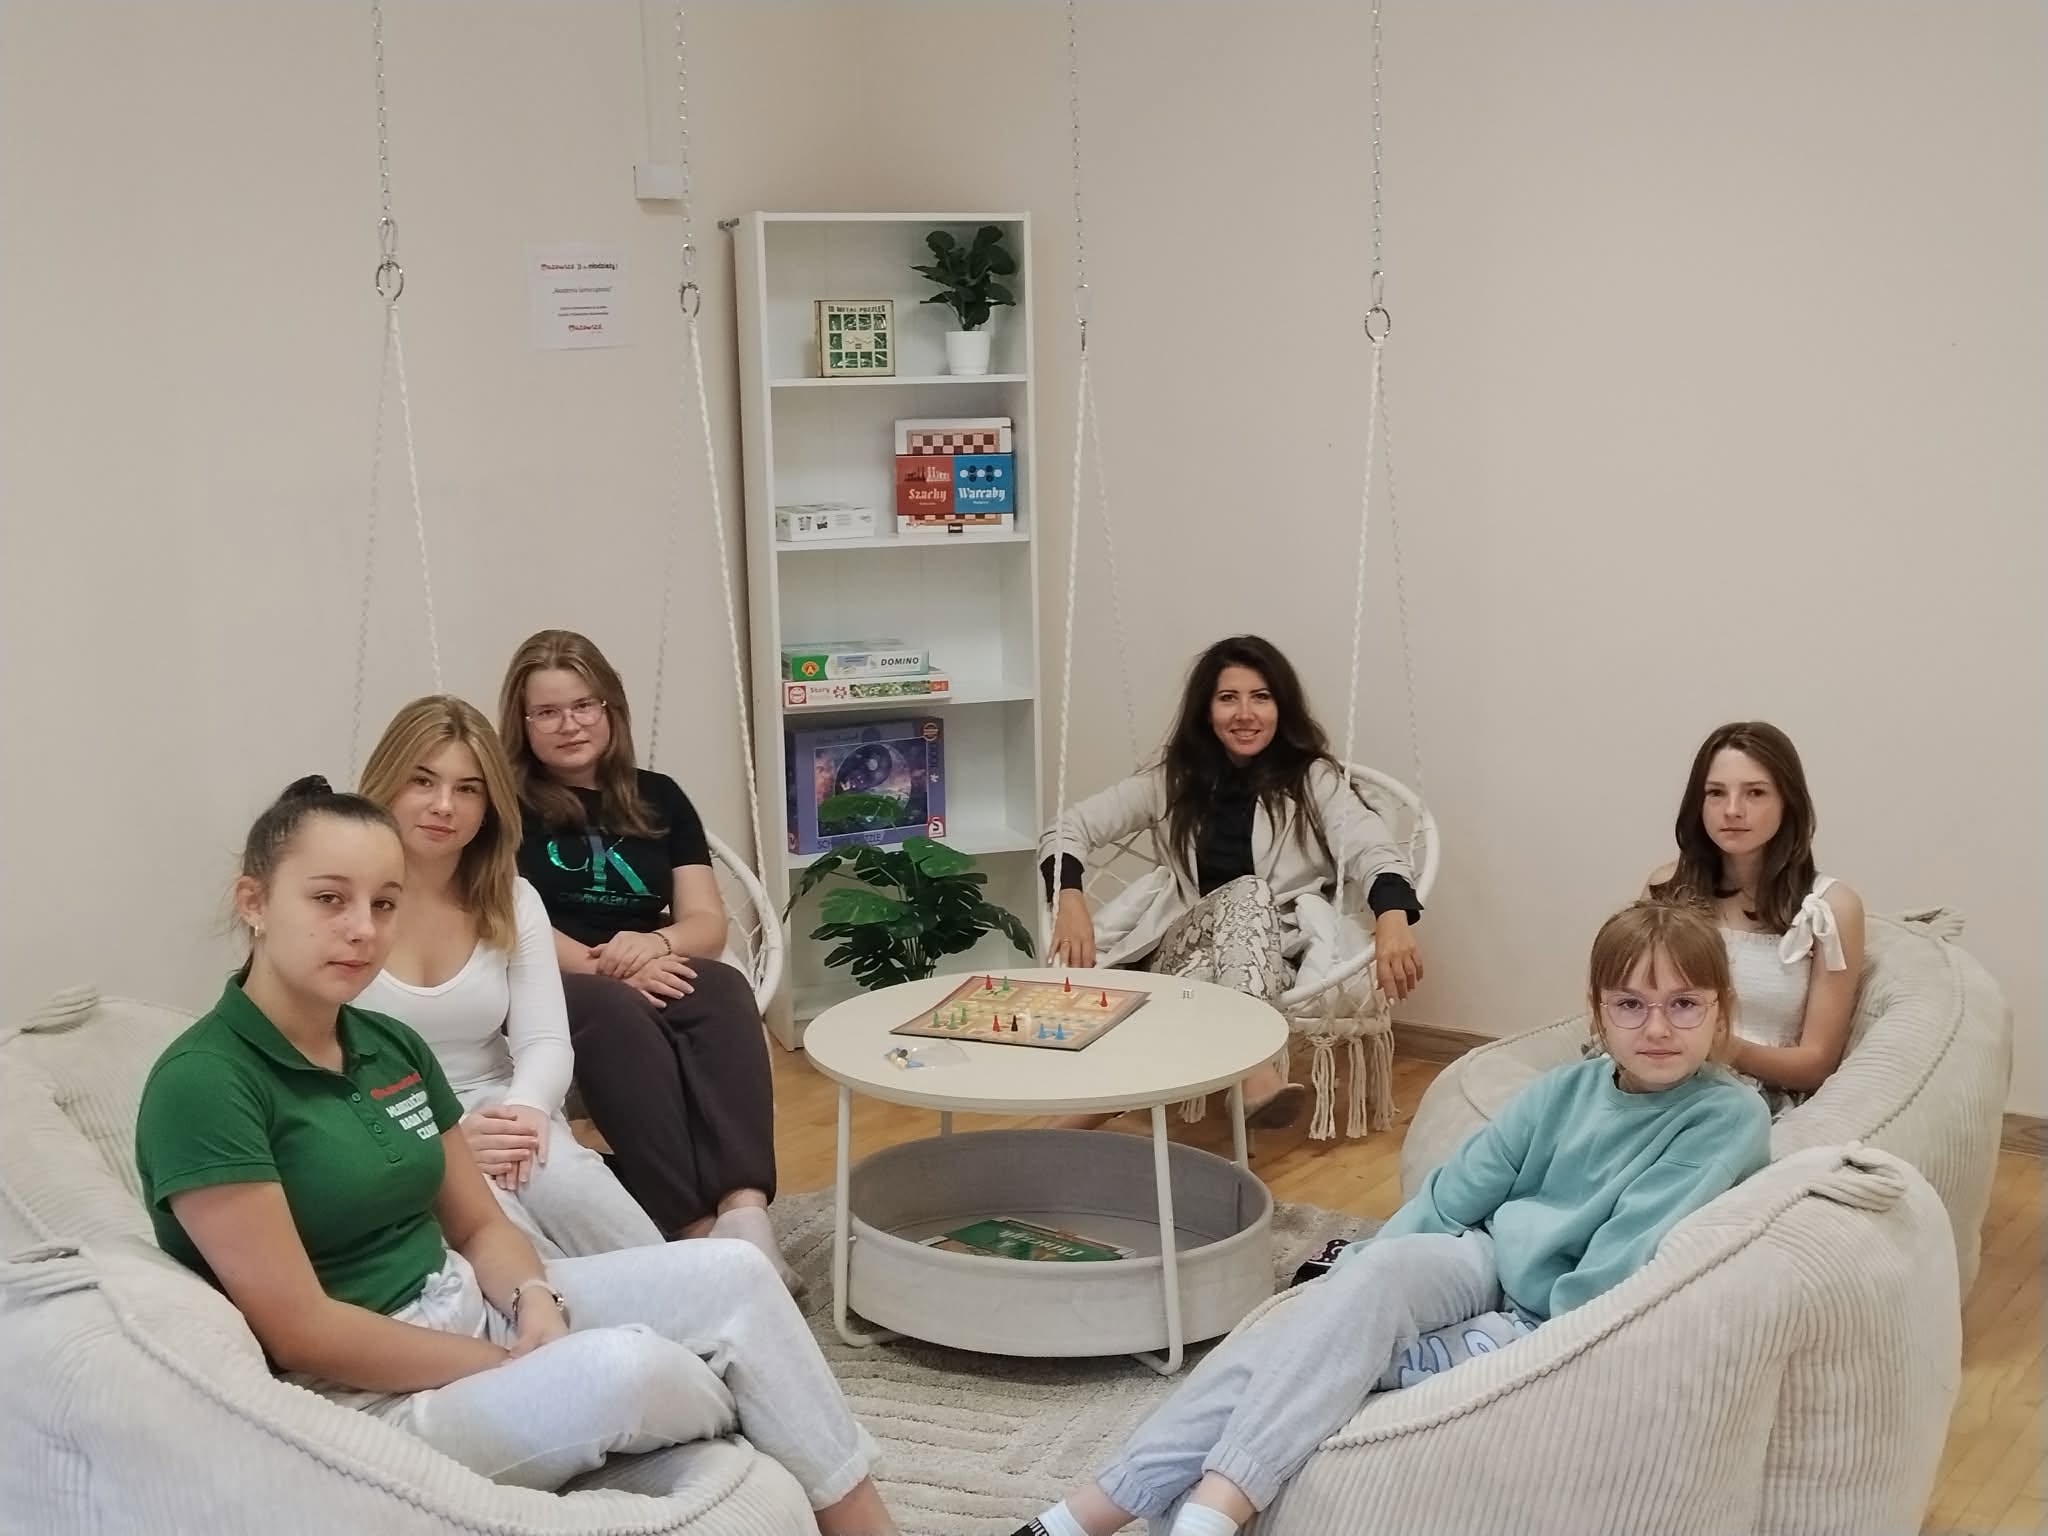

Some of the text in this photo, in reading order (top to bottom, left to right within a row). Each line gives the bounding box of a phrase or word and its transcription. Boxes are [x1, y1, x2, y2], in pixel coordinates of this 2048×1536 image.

[859, 305, 886, 313] PUZZLES
[908, 488, 947, 502] Szachy
[958, 487, 1006, 502] Warcaby
[881, 657, 919, 666] DOMINO
